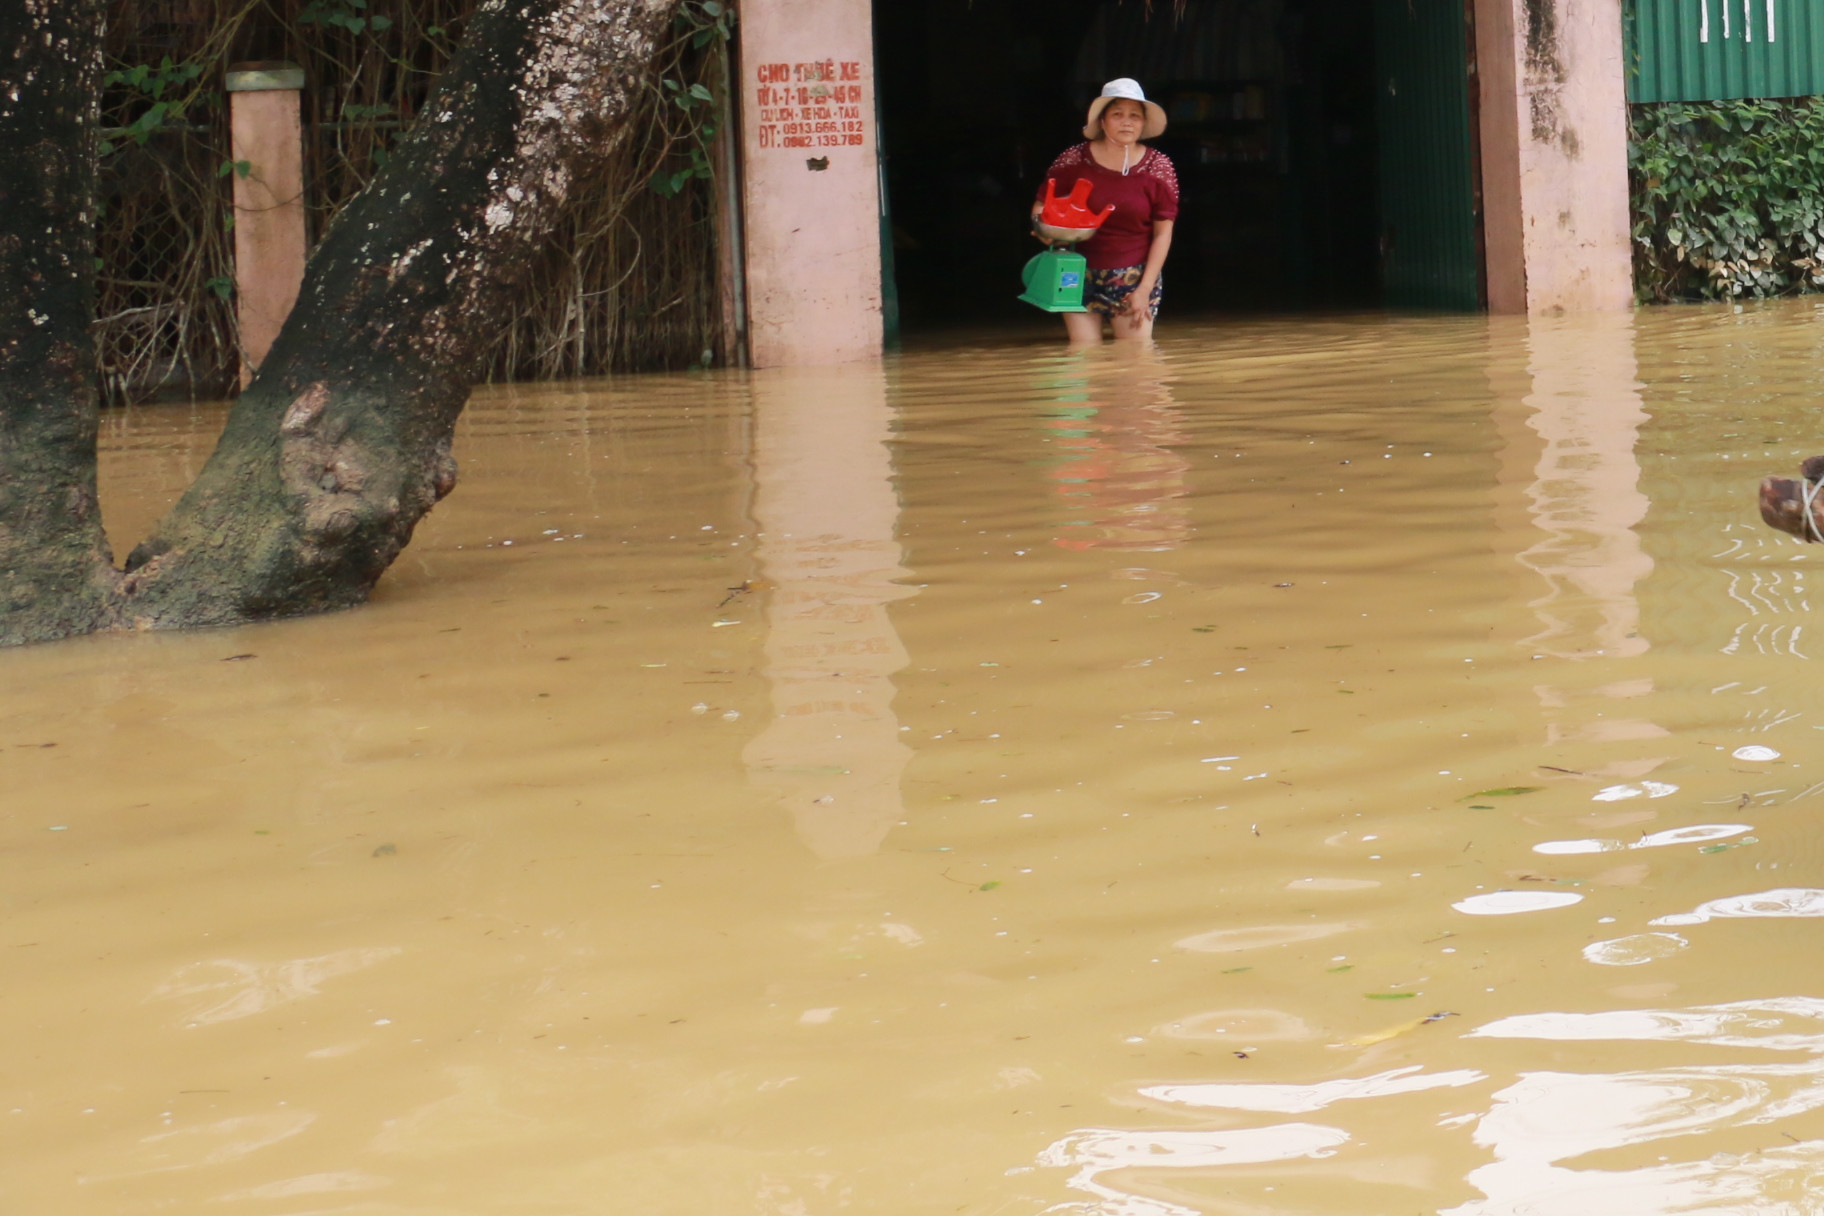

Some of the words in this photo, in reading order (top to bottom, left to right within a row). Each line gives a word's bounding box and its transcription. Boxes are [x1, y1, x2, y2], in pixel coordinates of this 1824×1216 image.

[757, 63, 790, 83] CHO
[839, 61, 860, 81] XE
[801, 107, 812, 120] XE
[783, 121, 863, 135] 0913.666.182
